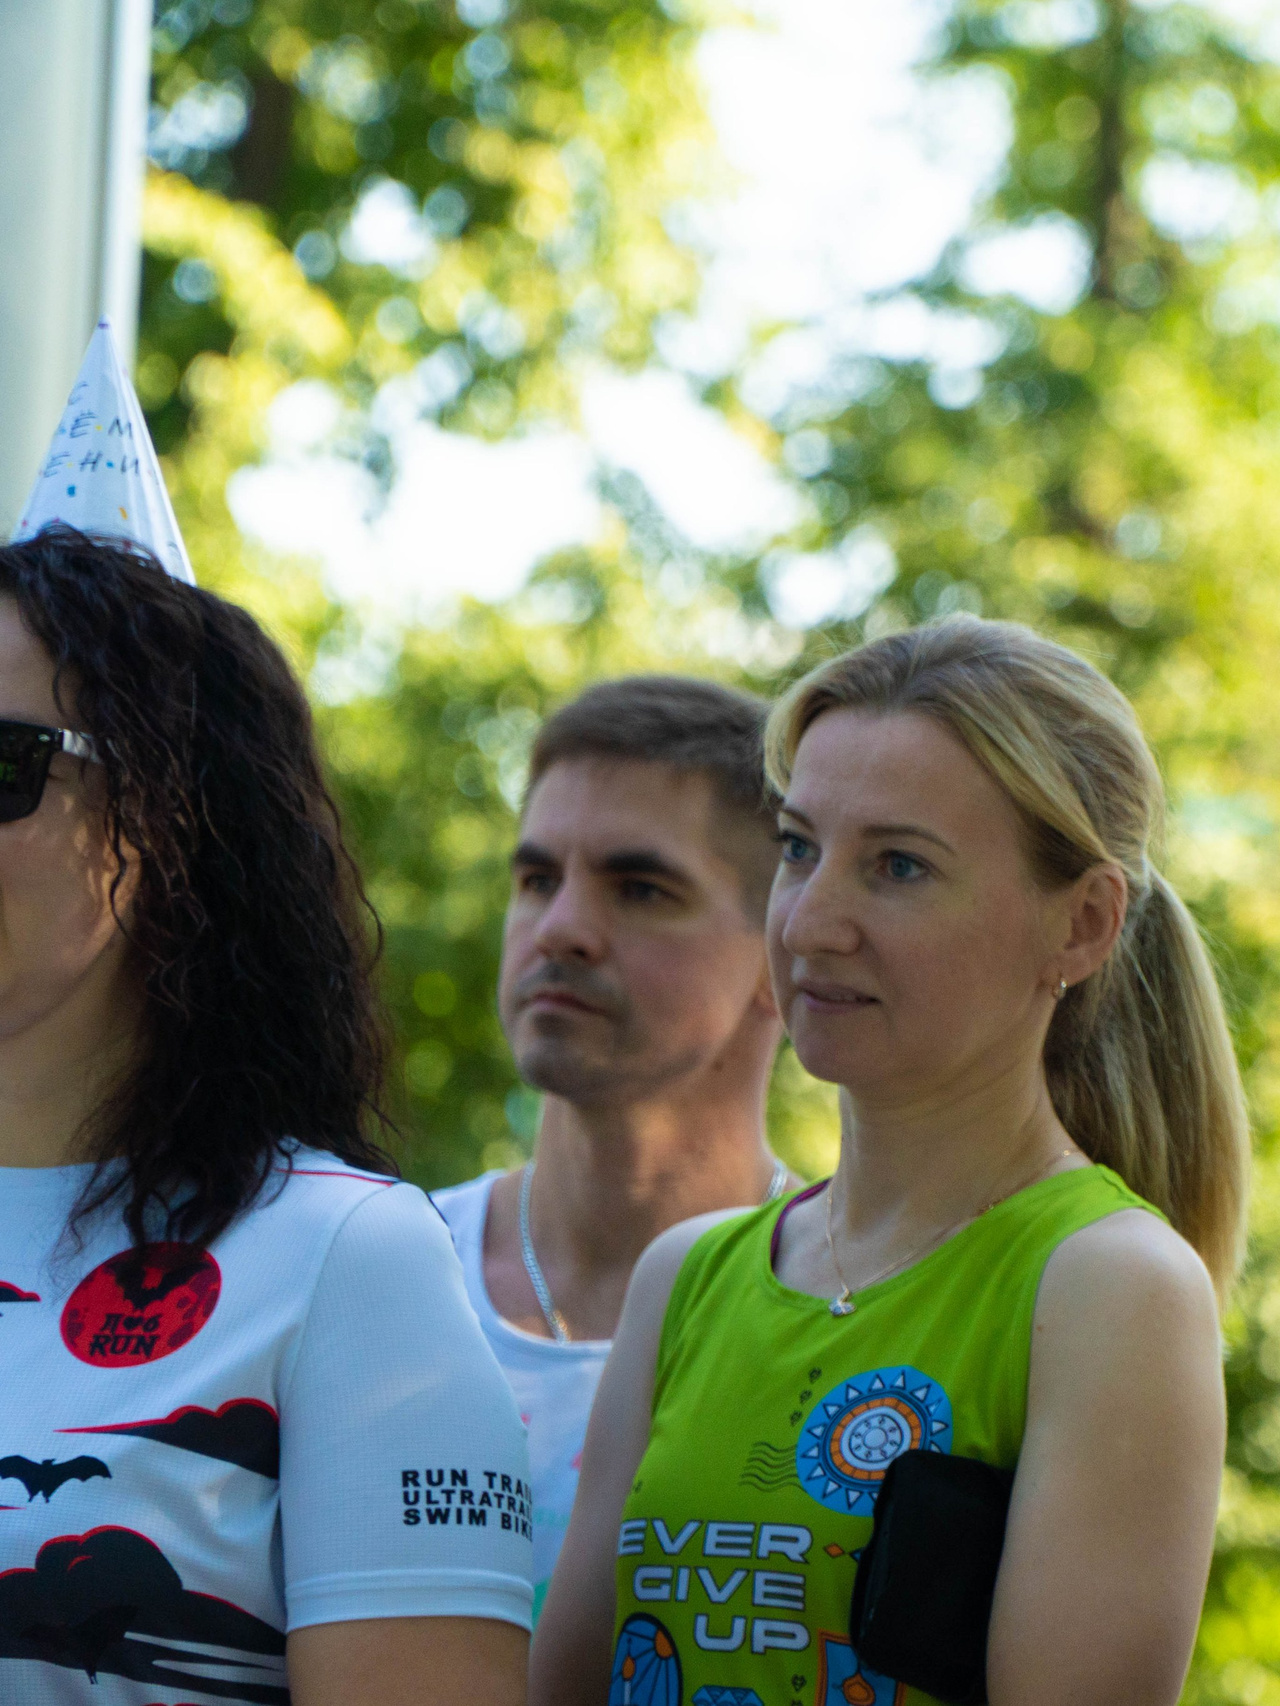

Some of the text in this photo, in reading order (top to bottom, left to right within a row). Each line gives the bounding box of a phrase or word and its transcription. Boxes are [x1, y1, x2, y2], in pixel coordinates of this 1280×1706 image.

[89, 1334, 161, 1358] RUN
[402, 1469, 468, 1488] RUN
[403, 1507, 487, 1526] SWIM
[633, 1565, 806, 1611] GIVE
[694, 1613, 811, 1655] UP
